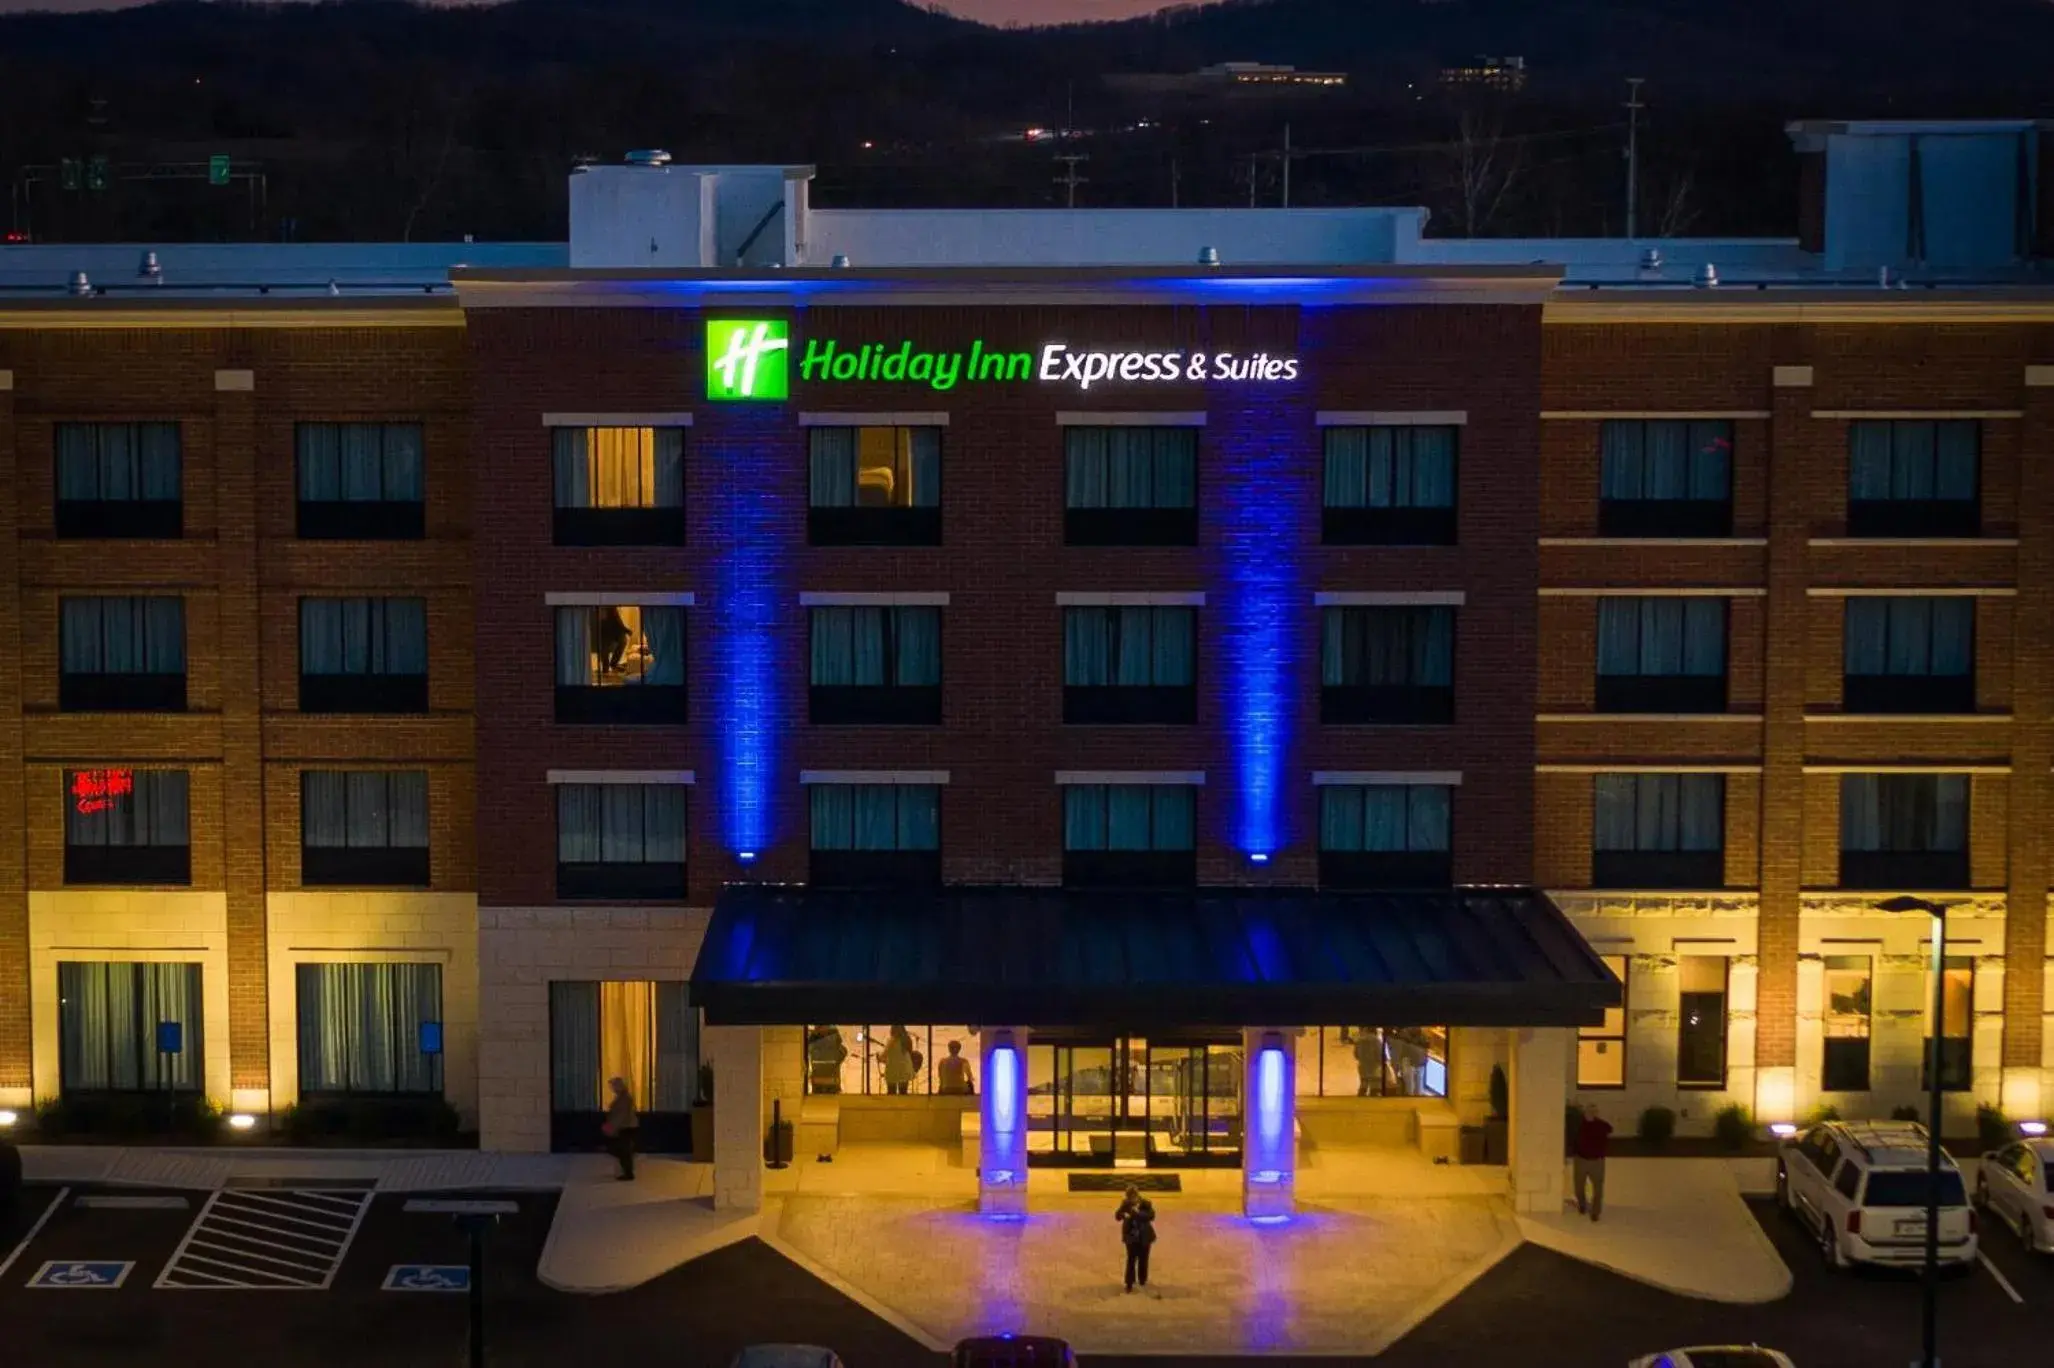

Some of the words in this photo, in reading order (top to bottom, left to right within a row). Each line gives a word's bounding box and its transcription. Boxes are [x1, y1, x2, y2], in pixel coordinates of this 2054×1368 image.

[800, 340, 961, 390] Holiday
[967, 339, 1032, 380] Inn
[1040, 344, 1181, 390] Express
[1186, 352, 1207, 380] &
[1213, 352, 1298, 381] Suites
